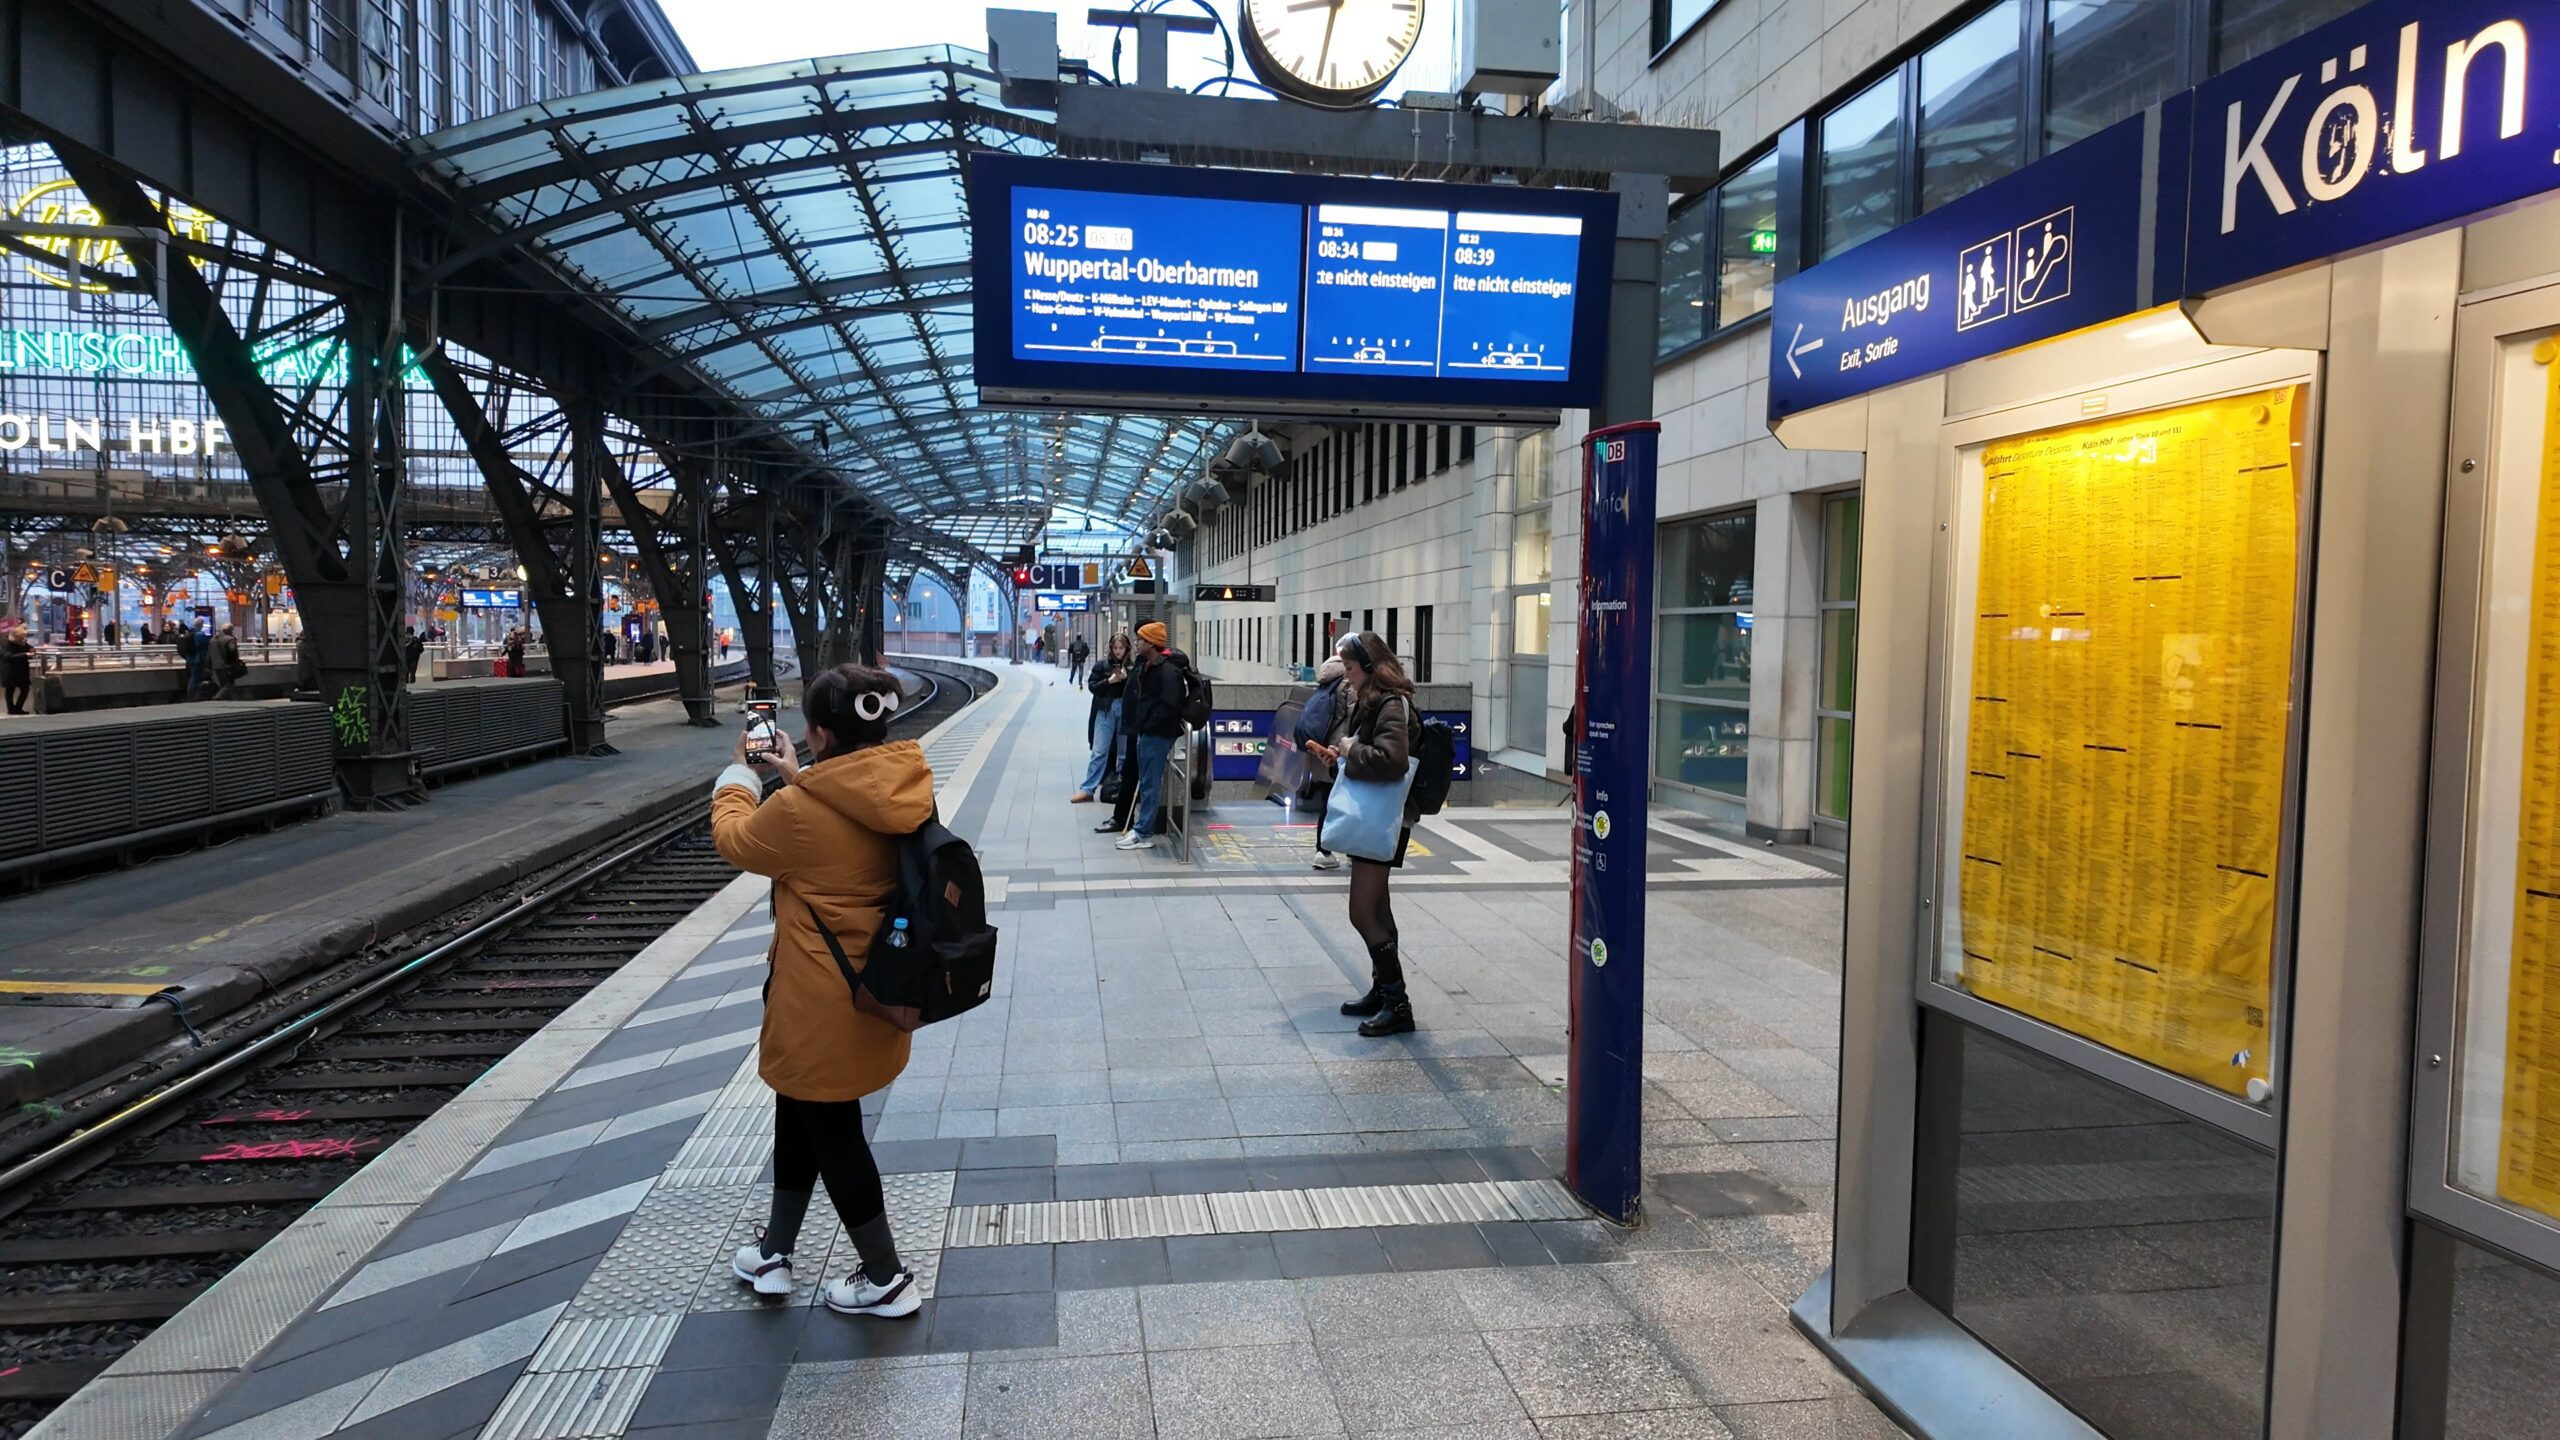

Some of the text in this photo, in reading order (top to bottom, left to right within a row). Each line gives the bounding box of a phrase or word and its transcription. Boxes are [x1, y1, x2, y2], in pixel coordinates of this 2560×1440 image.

[2220, 17, 2528, 236] Köln
[1023, 222, 1079, 248] 08:25
[1318, 240, 1359, 259] 08:34
[1455, 247, 1495, 266] 08:39
[1023, 251, 1259, 288] Wuppertal-Oberbarmen
[1335, 268, 1369, 287] nicht
[1370, 270, 1436, 293] einsteigen
[1477, 275, 1510, 293] nicht
[1841, 273, 1930, 332] Ausgang
[1840, 336, 1899, 372] Exit, Sortie
[130, 417, 225, 456] HBF
[1607, 442, 1623, 460] DB
[51, 570, 66, 588] C
[490, 566, 498, 578] 3
[1030, 565, 1066, 584] C 1
[1591, 599, 1627, 610] Information
[1596, 789, 1609, 802] Info
